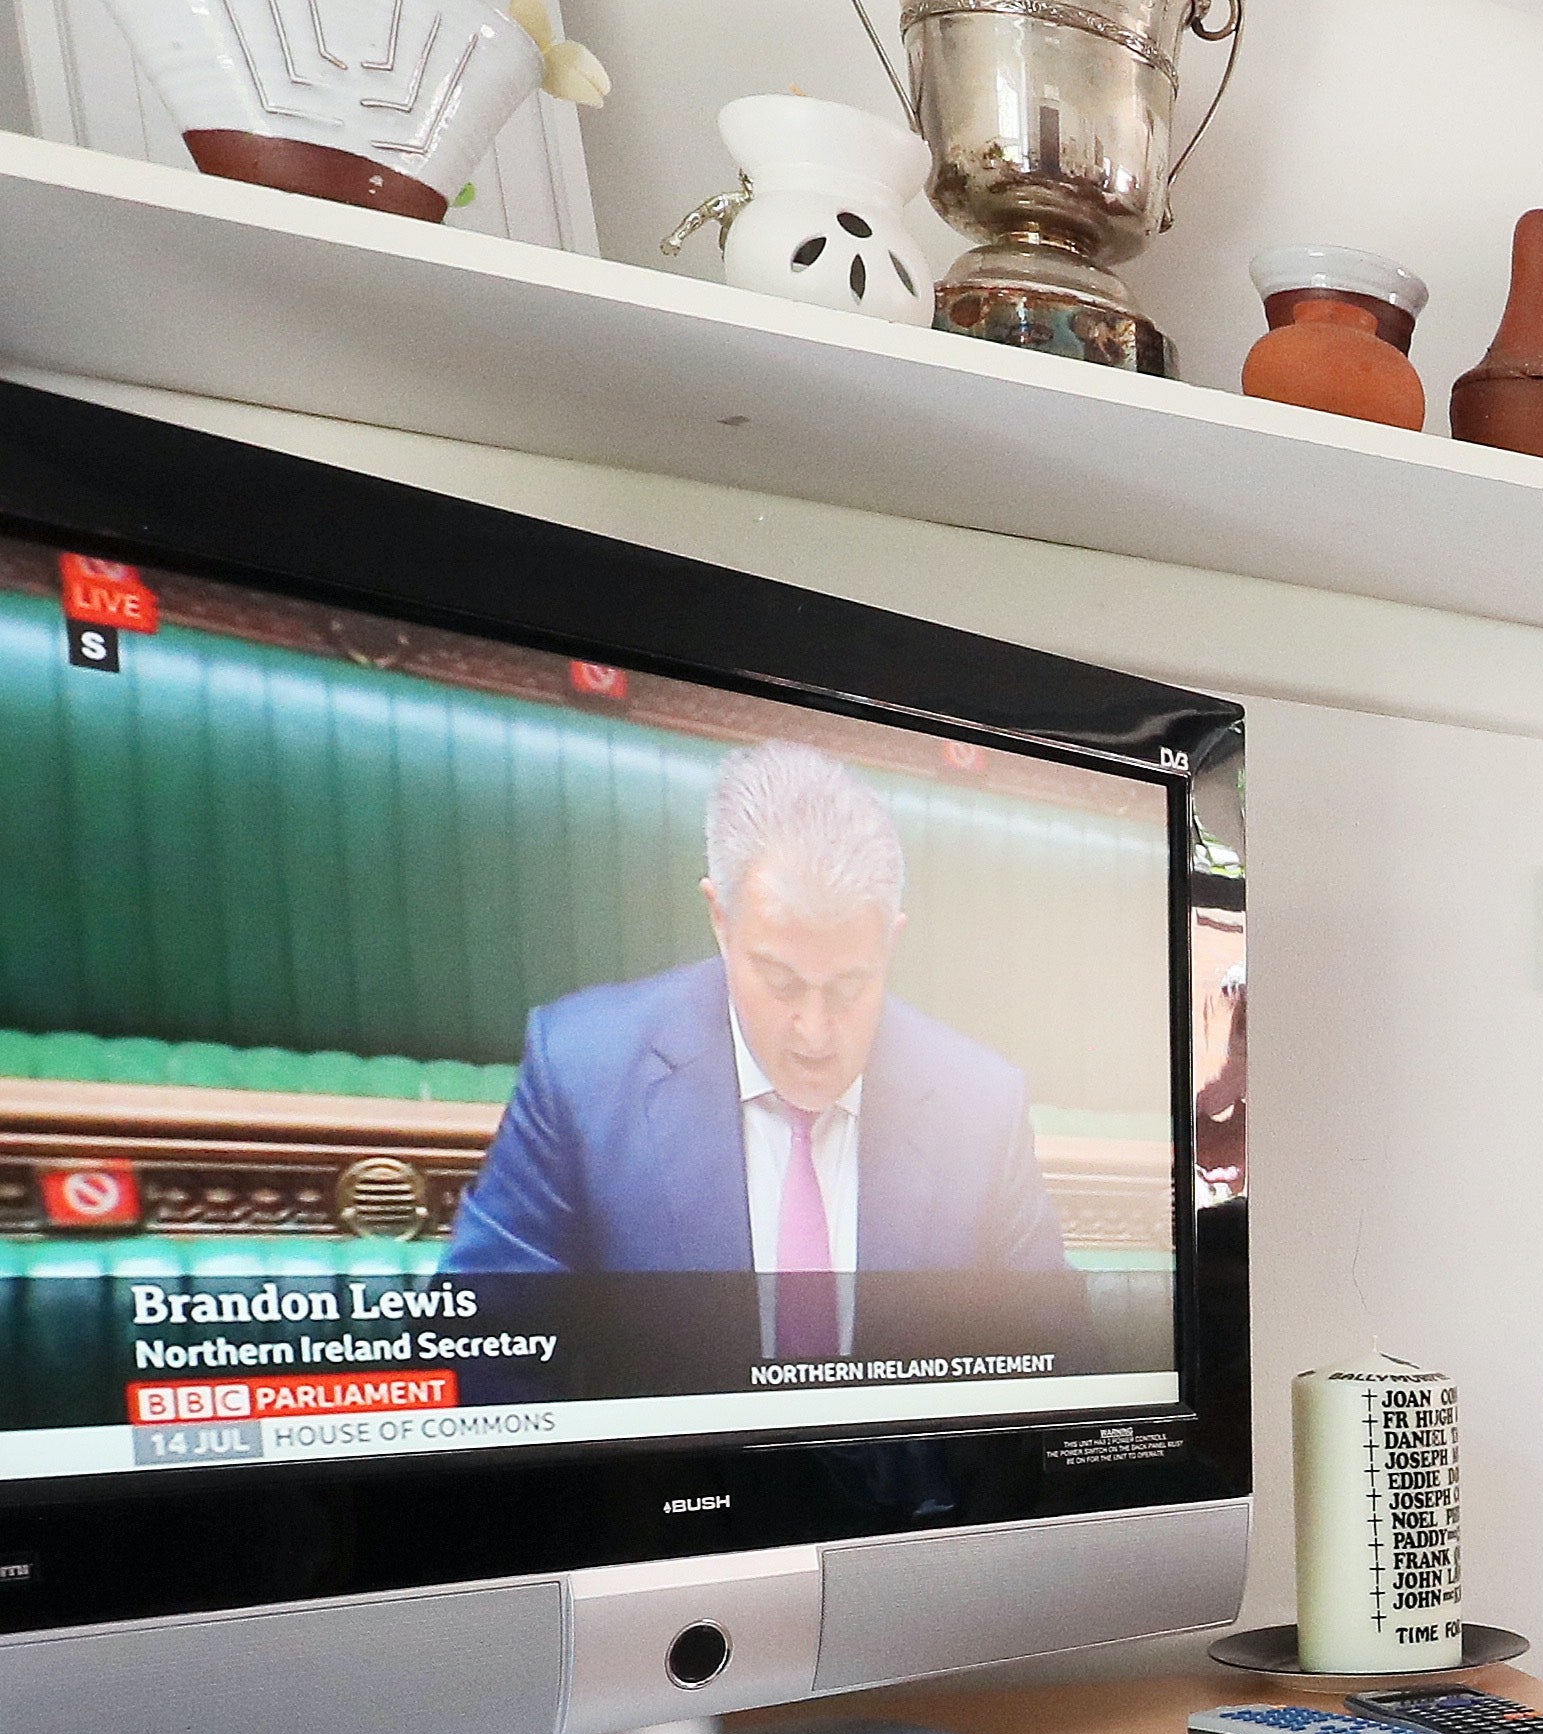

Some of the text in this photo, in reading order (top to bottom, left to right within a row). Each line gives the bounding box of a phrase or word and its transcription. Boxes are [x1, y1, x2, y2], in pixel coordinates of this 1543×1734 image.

[72, 583, 141, 618] LIVE
[81, 631, 107, 660] S
[130, 1281, 478, 1326] Brandon Lewis
[136, 1331, 557, 1369] Northern Ireland Secretary
[751, 1354, 1056, 1386] NORTHERN IRELAND STATEMENT
[139, 1378, 447, 1421] BBC PARLIAMENT
[1381, 1389, 1431, 1408] JOAN
[274, 1410, 556, 1447] HOUSE OF COMMONS
[1383, 1411, 1409, 1429] FR
[1415, 1407, 1453, 1428] HUGH
[151, 1428, 250, 1456] 14 JUL
[1384, 1428, 1447, 1449] DANIEL
[1060, 1449, 1082, 1457] POWER
[1384, 1448, 1448, 1469] JOSEPH
[1387, 1470, 1441, 1490] EDDIE
[672, 1494, 731, 1513] BUSH
[1389, 1488, 1451, 1510] JOSEPH
[1391, 1511, 1438, 1529] NOEL
[1393, 1528, 1448, 1550] PADDY
[1393, 1548, 1451, 1570] FRANK
[1393, 1569, 1442, 1590] JOHN
[1393, 1589, 1441, 1610] JOHN
[1395, 1625, 1439, 1644] TIME
